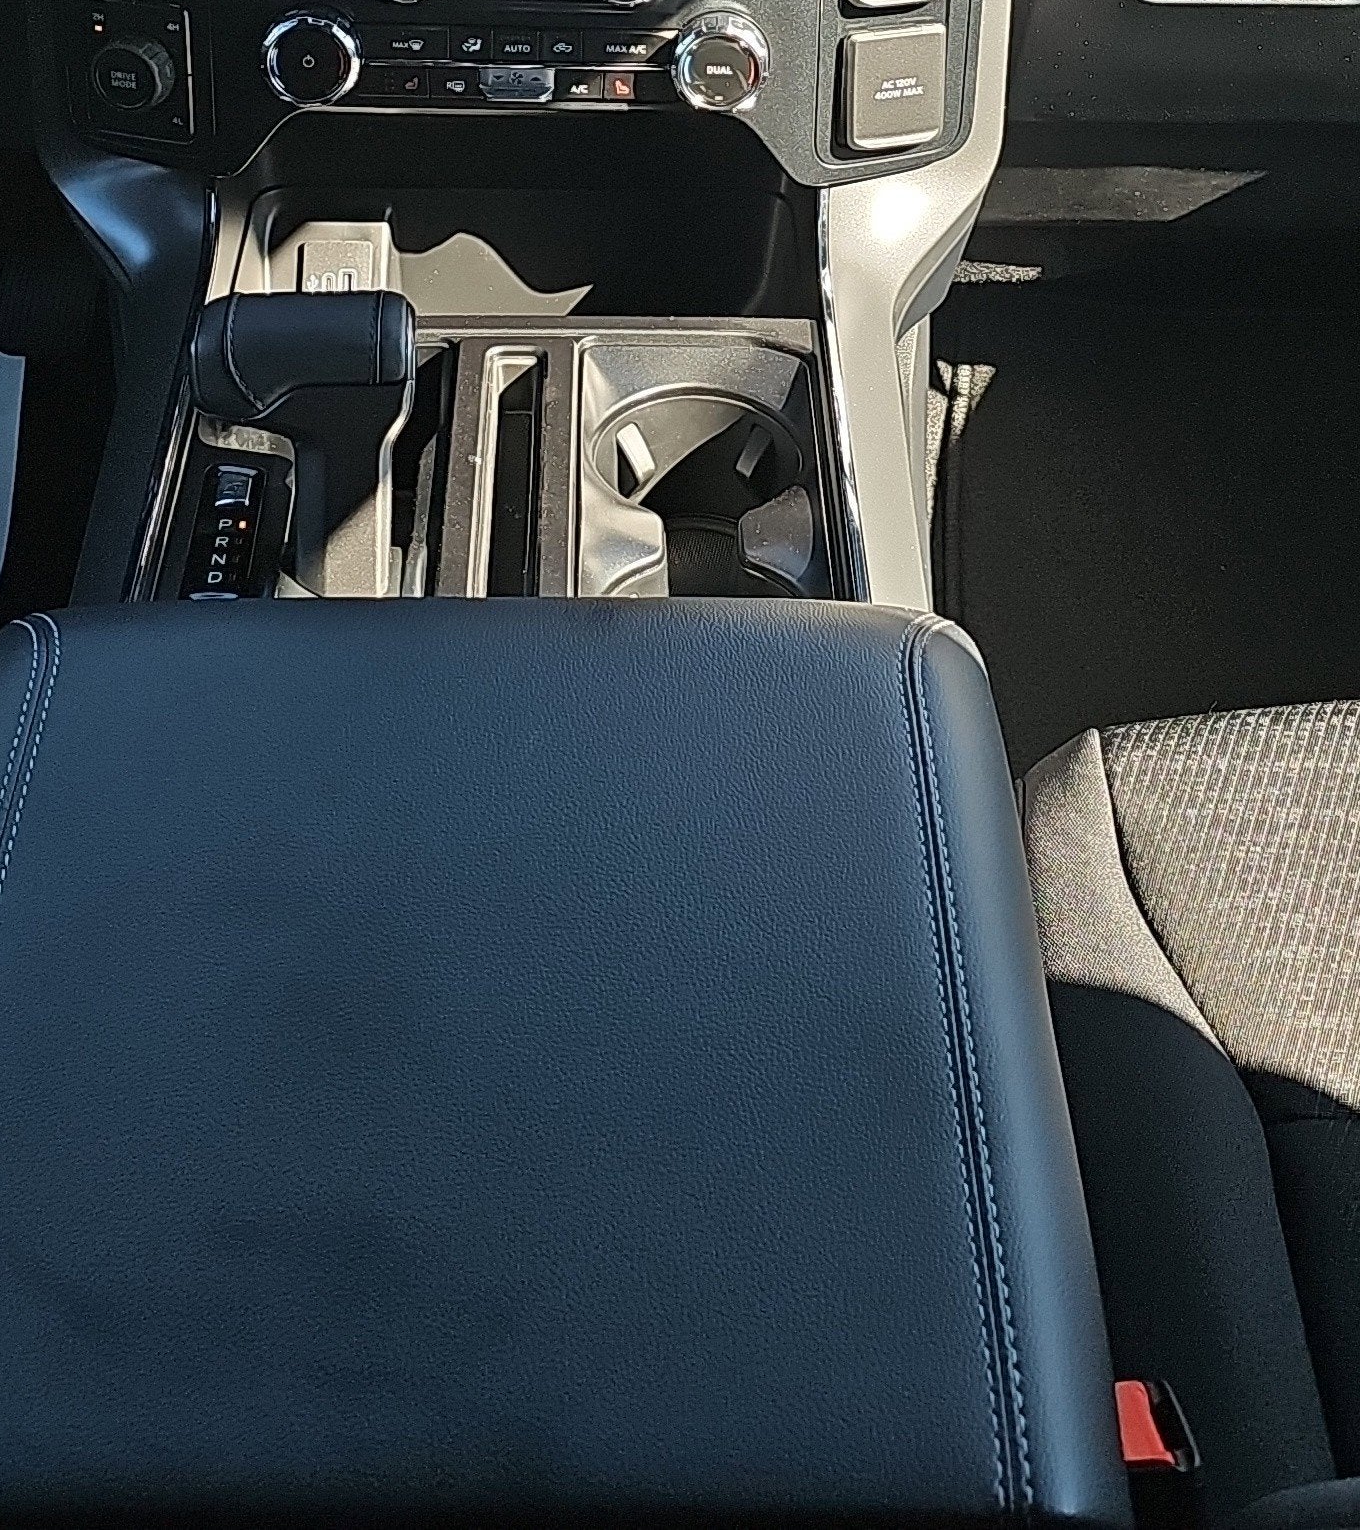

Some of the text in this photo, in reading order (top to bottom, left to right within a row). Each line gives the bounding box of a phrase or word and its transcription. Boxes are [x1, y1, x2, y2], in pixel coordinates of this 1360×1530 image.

[393, 41, 409, 50] MAX
[504, 45, 531, 53] AUTO
[606, 45, 647, 54] MAX A/C
[706, 65, 734, 75] DUAL
[110, 71, 136, 81] DRIVE
[111, 80, 137, 90] MODE
[881, 77, 917, 90] AC 120V
[570, 85, 589, 94] A/C
[874, 86, 924, 100] 400W MAX
[218, 519, 233, 531] P
[214, 536, 229, 548] R
[211, 554, 227, 566] N
[207, 572, 223, 584] D
